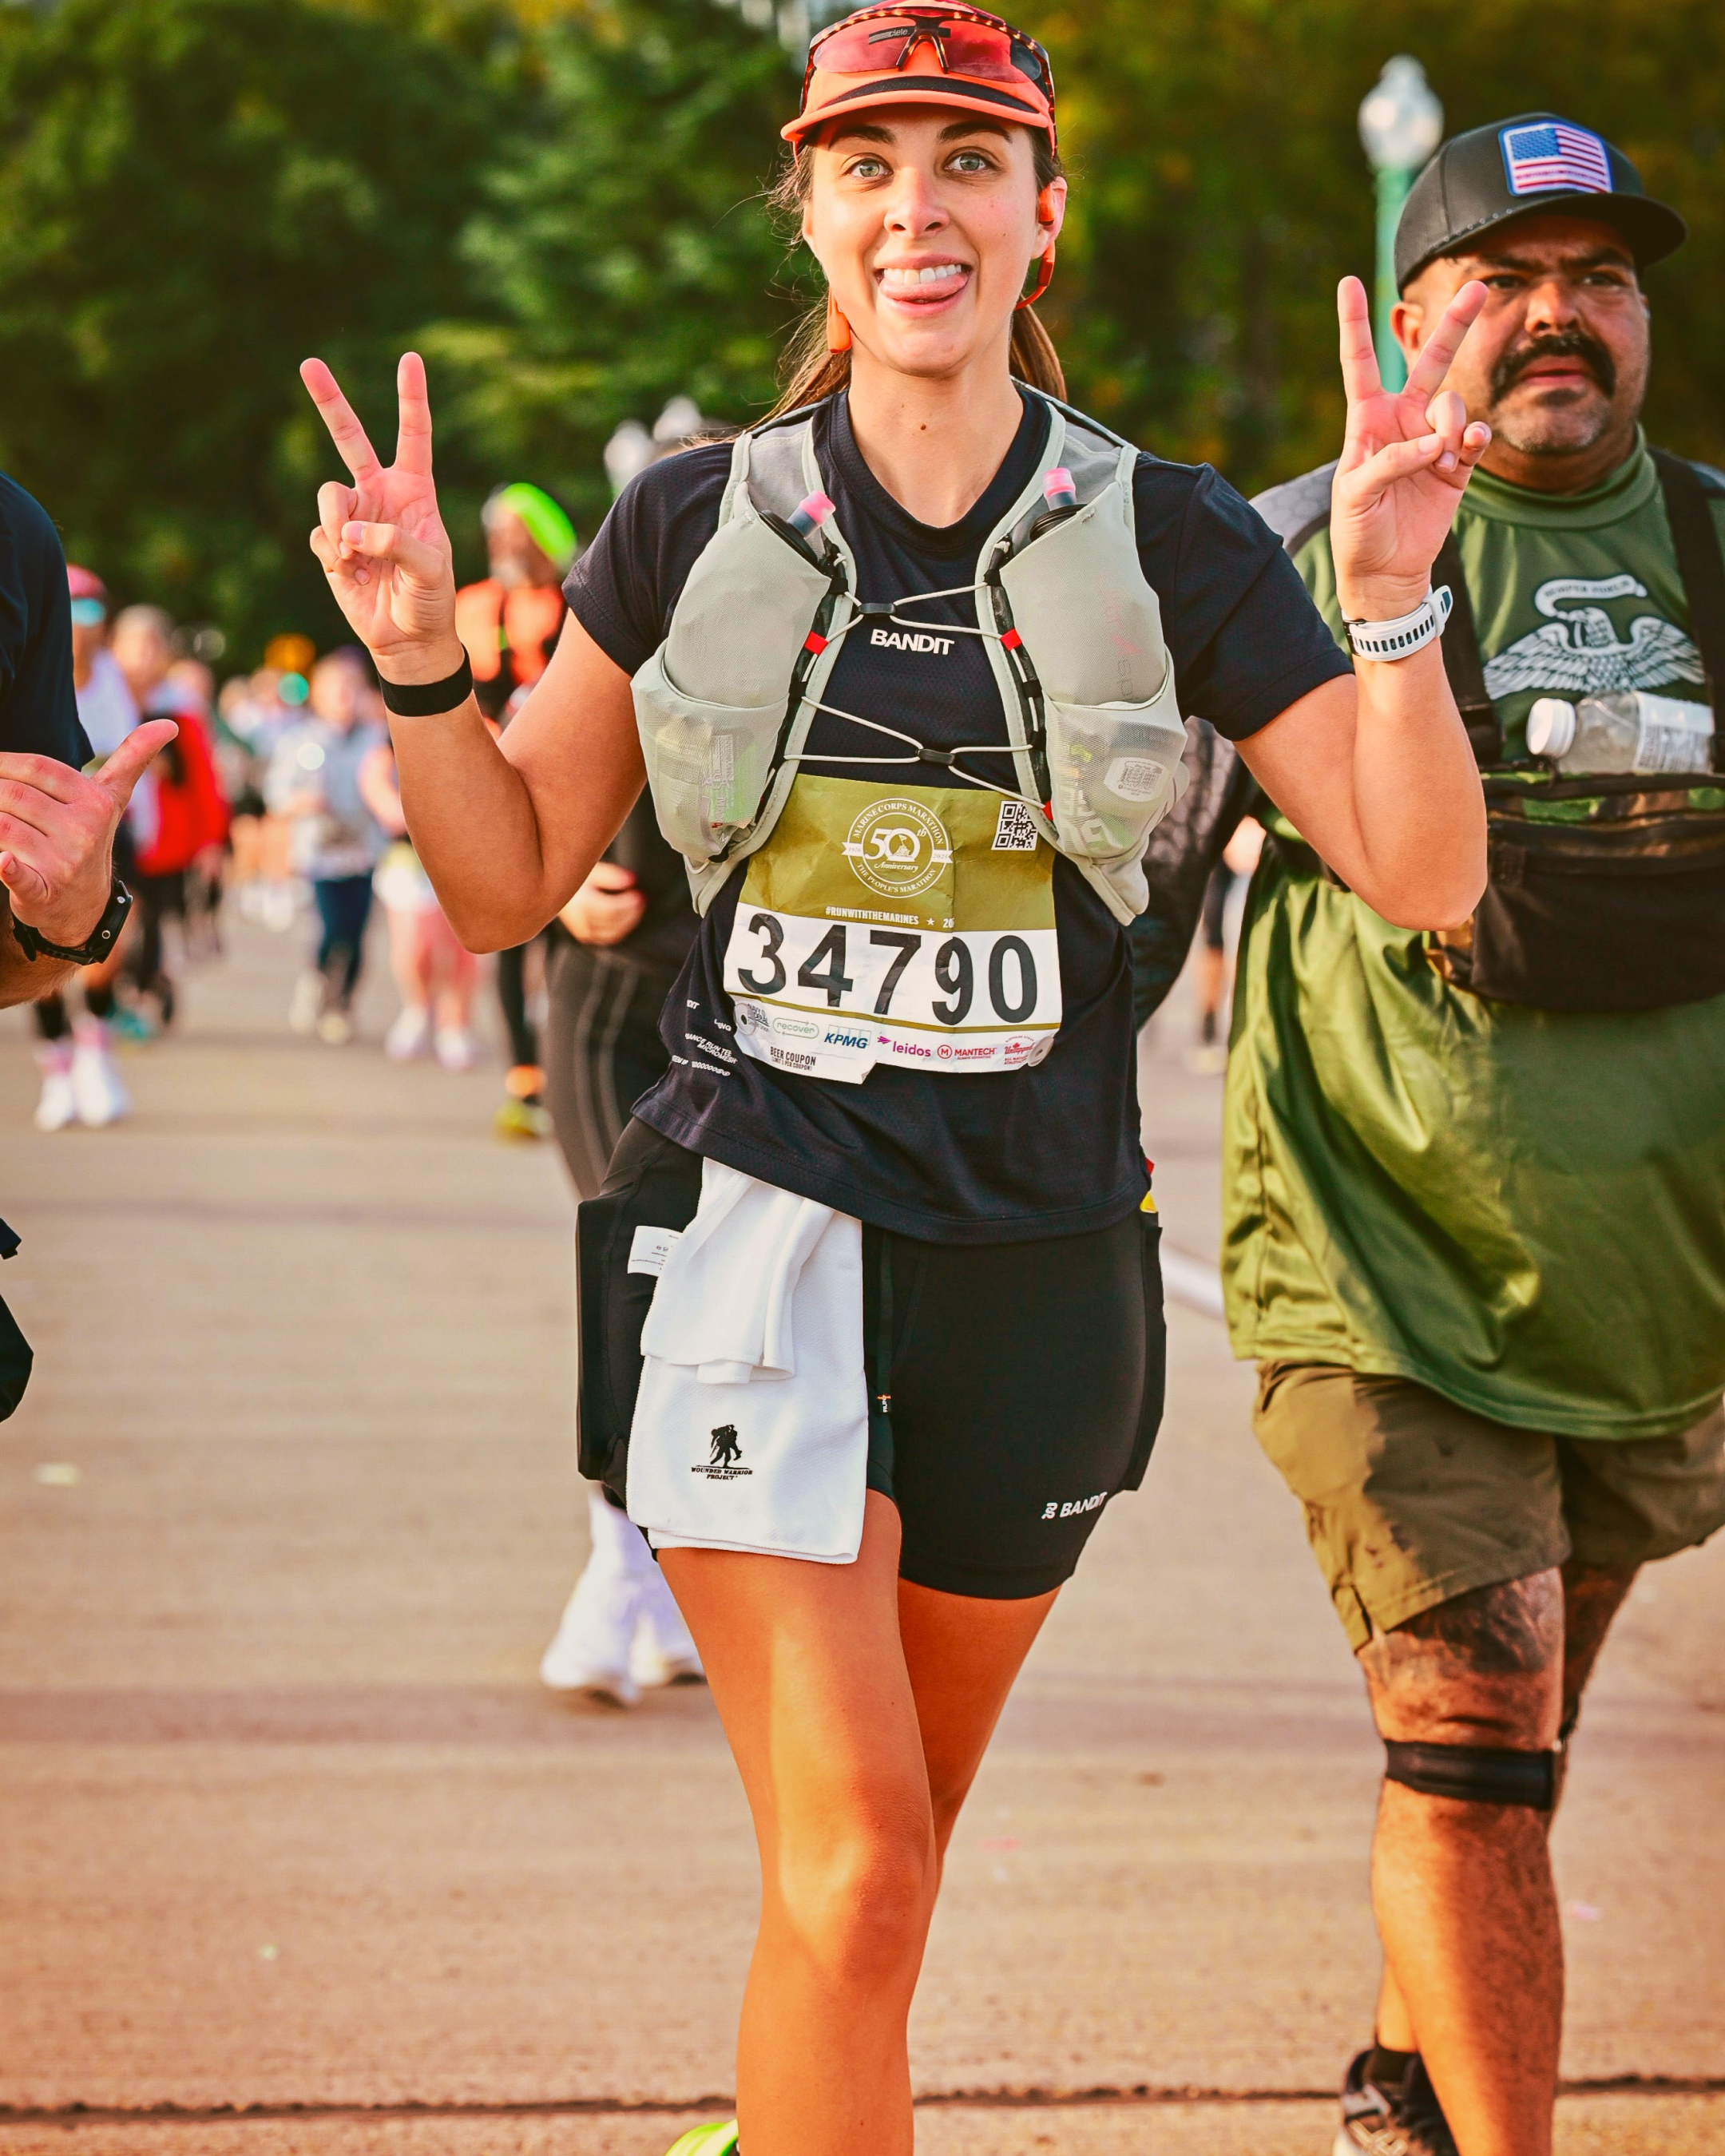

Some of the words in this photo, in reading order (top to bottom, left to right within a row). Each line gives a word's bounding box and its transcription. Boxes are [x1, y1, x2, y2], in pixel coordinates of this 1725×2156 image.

[889, 28, 908, 37] ciele
[870, 628, 955, 655] BANDIT
[853, 808, 878, 838] MARINE
[878, 803, 907, 813] CORPS
[908, 805, 944, 845] MARATHON
[874, 862, 918, 874] Anniversary
[857, 862, 868, 878] THE
[867, 876, 899, 893] PEOPLE'S
[899, 868, 937, 894] MARATHON
[825, 906, 919, 925] #RUNWITHTHEMARINES
[942, 917, 955, 929] 20
[738, 913, 1037, 1025] 34790
[687, 1000, 700, 1009] DIT
[776, 1022, 815, 1034] recover
[684, 1032, 707, 1044] ANCE
[706, 1041, 721, 1052] RUN
[823, 1032, 869, 1049] KPMG
[892, 1040, 931, 1057] leidos
[770, 1046, 784, 1060] BEER
[785, 1052, 816, 1065] COUPON
[954, 1047, 995, 1056] MANTECH
[1060, 1492, 1108, 1518] BANDIT
